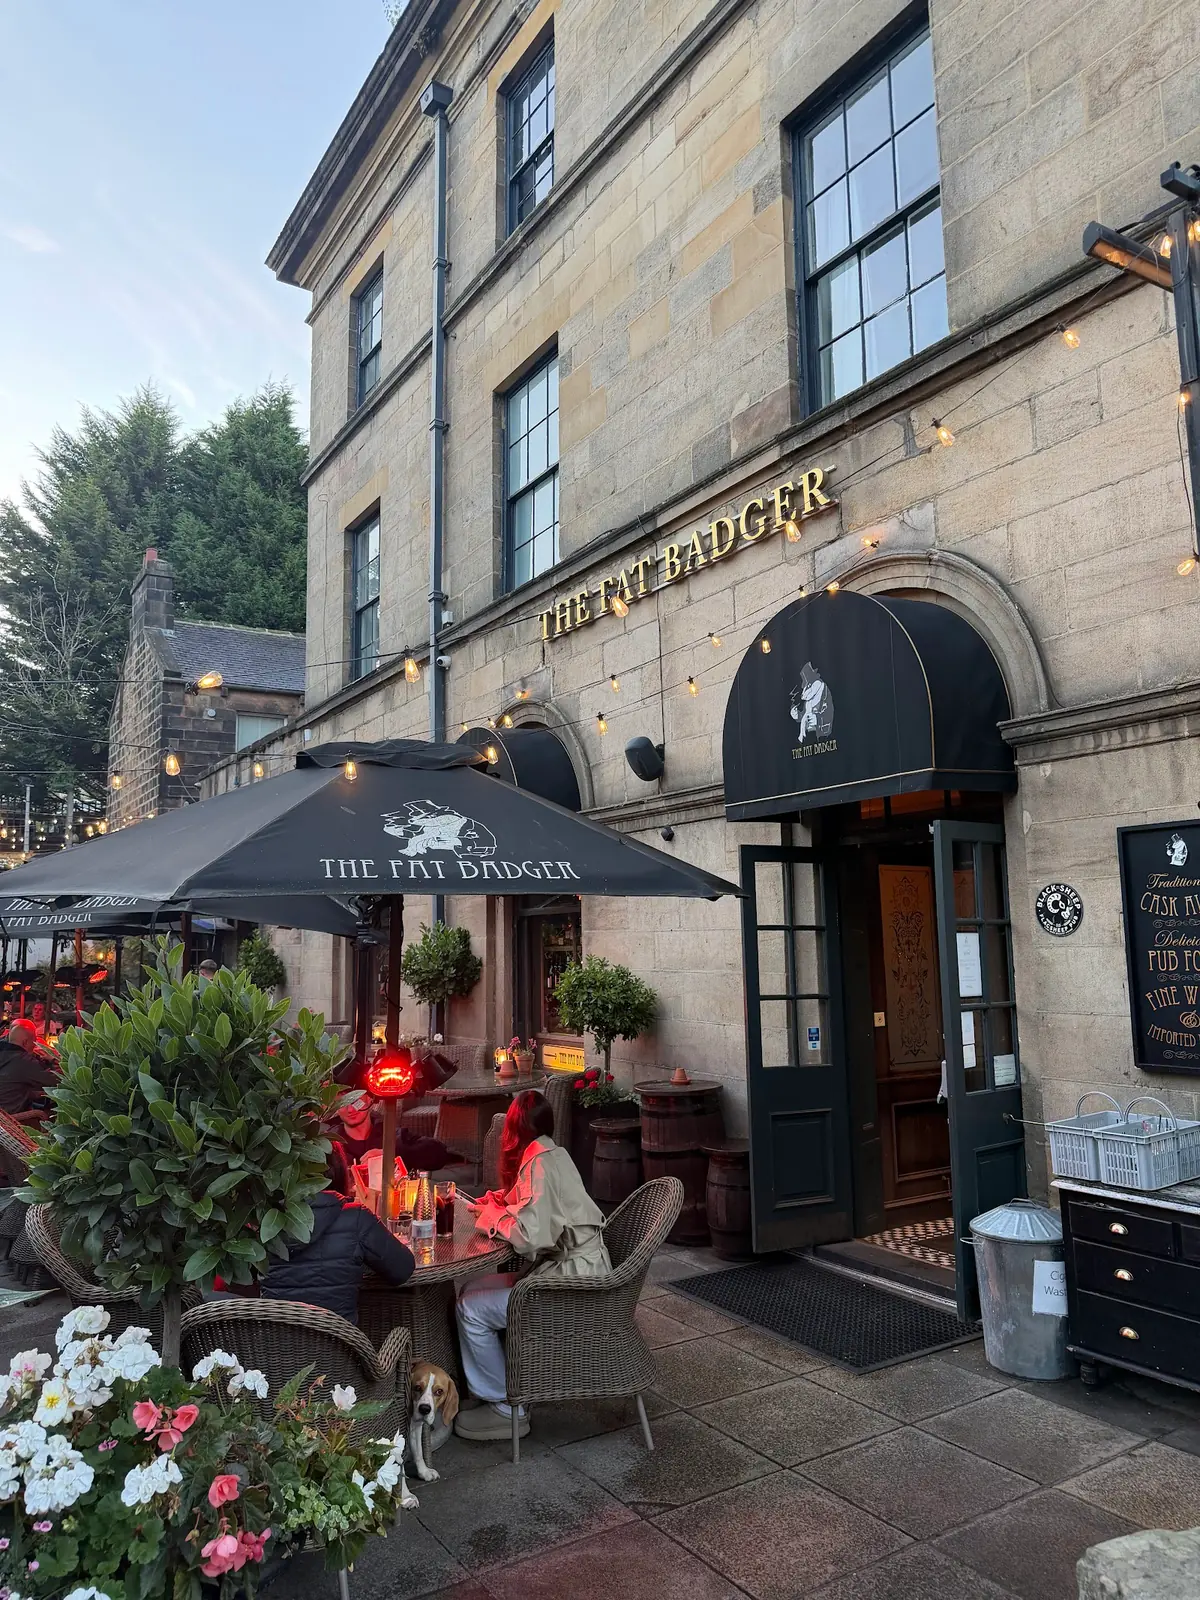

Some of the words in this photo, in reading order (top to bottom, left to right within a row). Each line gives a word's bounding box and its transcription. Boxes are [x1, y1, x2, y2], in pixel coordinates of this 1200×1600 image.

[538, 590, 591, 640] THE
[599, 554, 653, 614] FAT
[663, 466, 831, 583] BADGER
[813, 739, 838, 755] BADGER
[319, 858, 379, 879] THE
[388, 859, 445, 879] FAT
[456, 860, 581, 880] BADGER
[1036, 884, 1057, 908] BLACK
[1059, 884, 1081, 910] SHEEP
[1140, 891, 1179, 917] CASK
[1147, 950, 1179, 972] PUB
[1145, 985, 1180, 1011] FINE
[1147, 1024, 1196, 1047] IMPORTED
